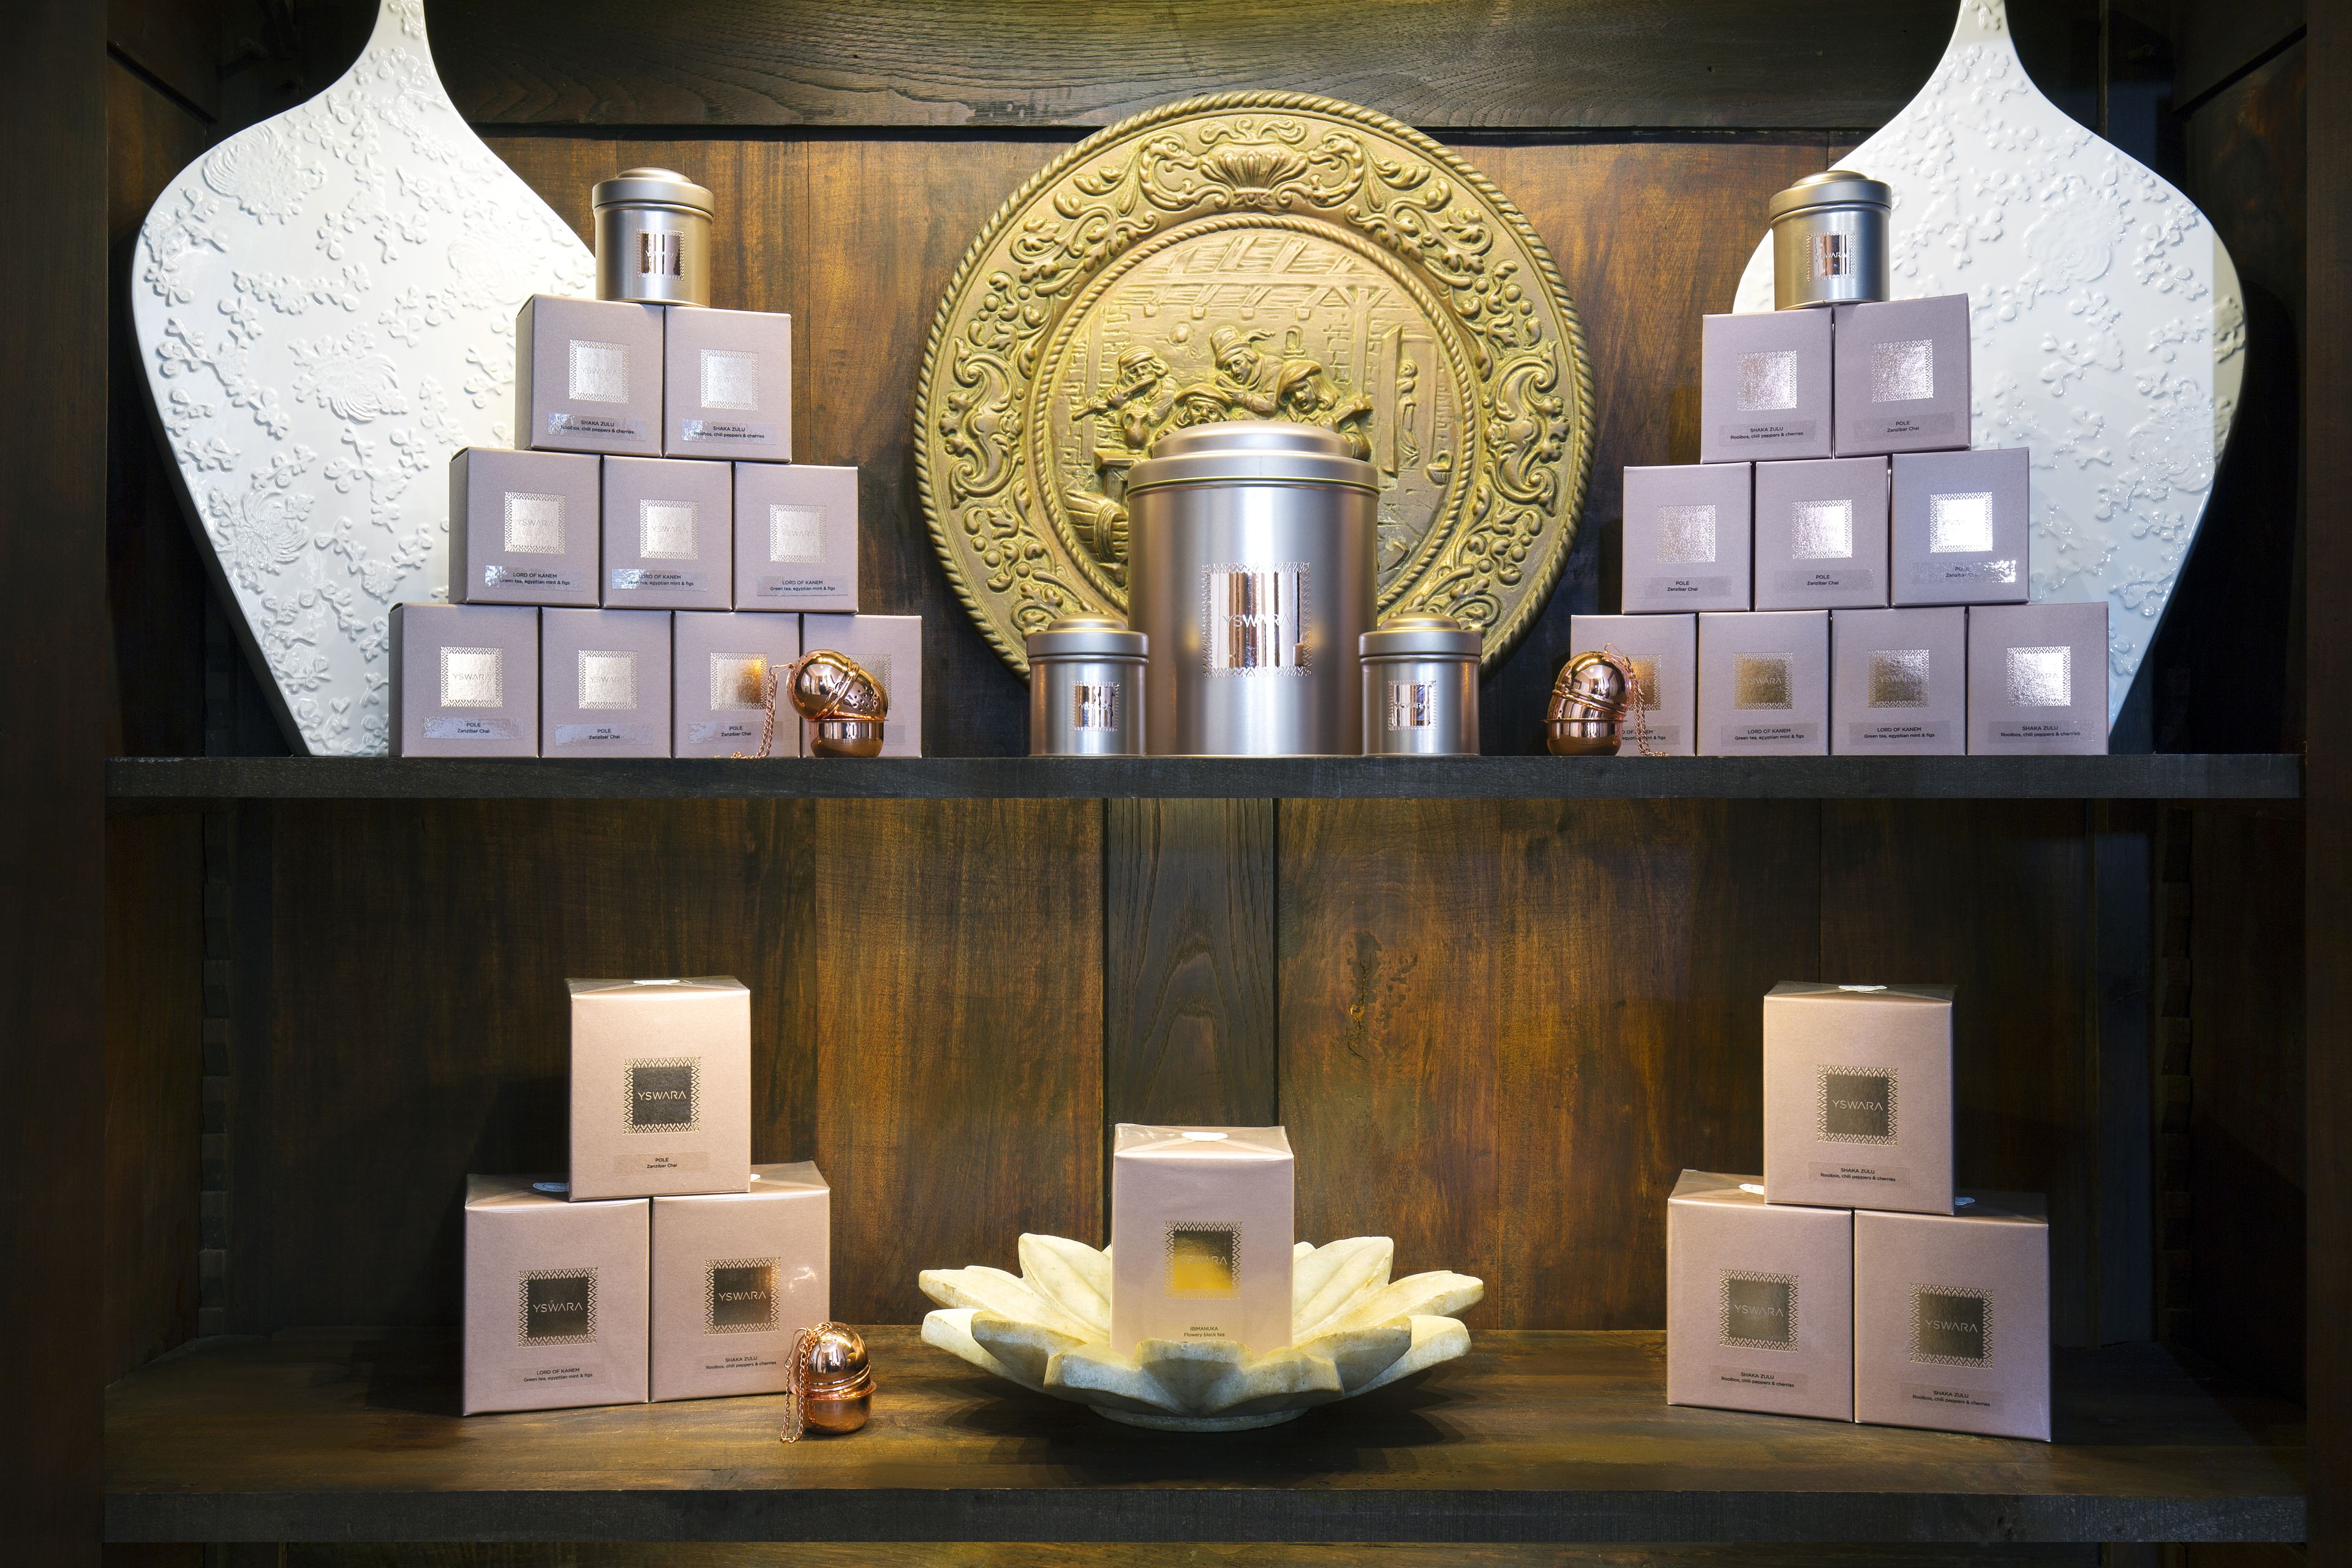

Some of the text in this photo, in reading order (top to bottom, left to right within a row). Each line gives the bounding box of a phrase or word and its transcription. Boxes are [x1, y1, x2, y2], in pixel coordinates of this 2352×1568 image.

[582, 368, 617, 376] YSWARA
[638, 1091, 687, 1100] YSWARA
[1832, 1099, 1883, 1111] YSWARA
[718, 1291, 766, 1301] YSWARA
[533, 1302, 583, 1313] YSWARA
[1734, 1304, 1784, 1317] YSWARA
[1925, 1319, 1978, 1333] YSWARA
